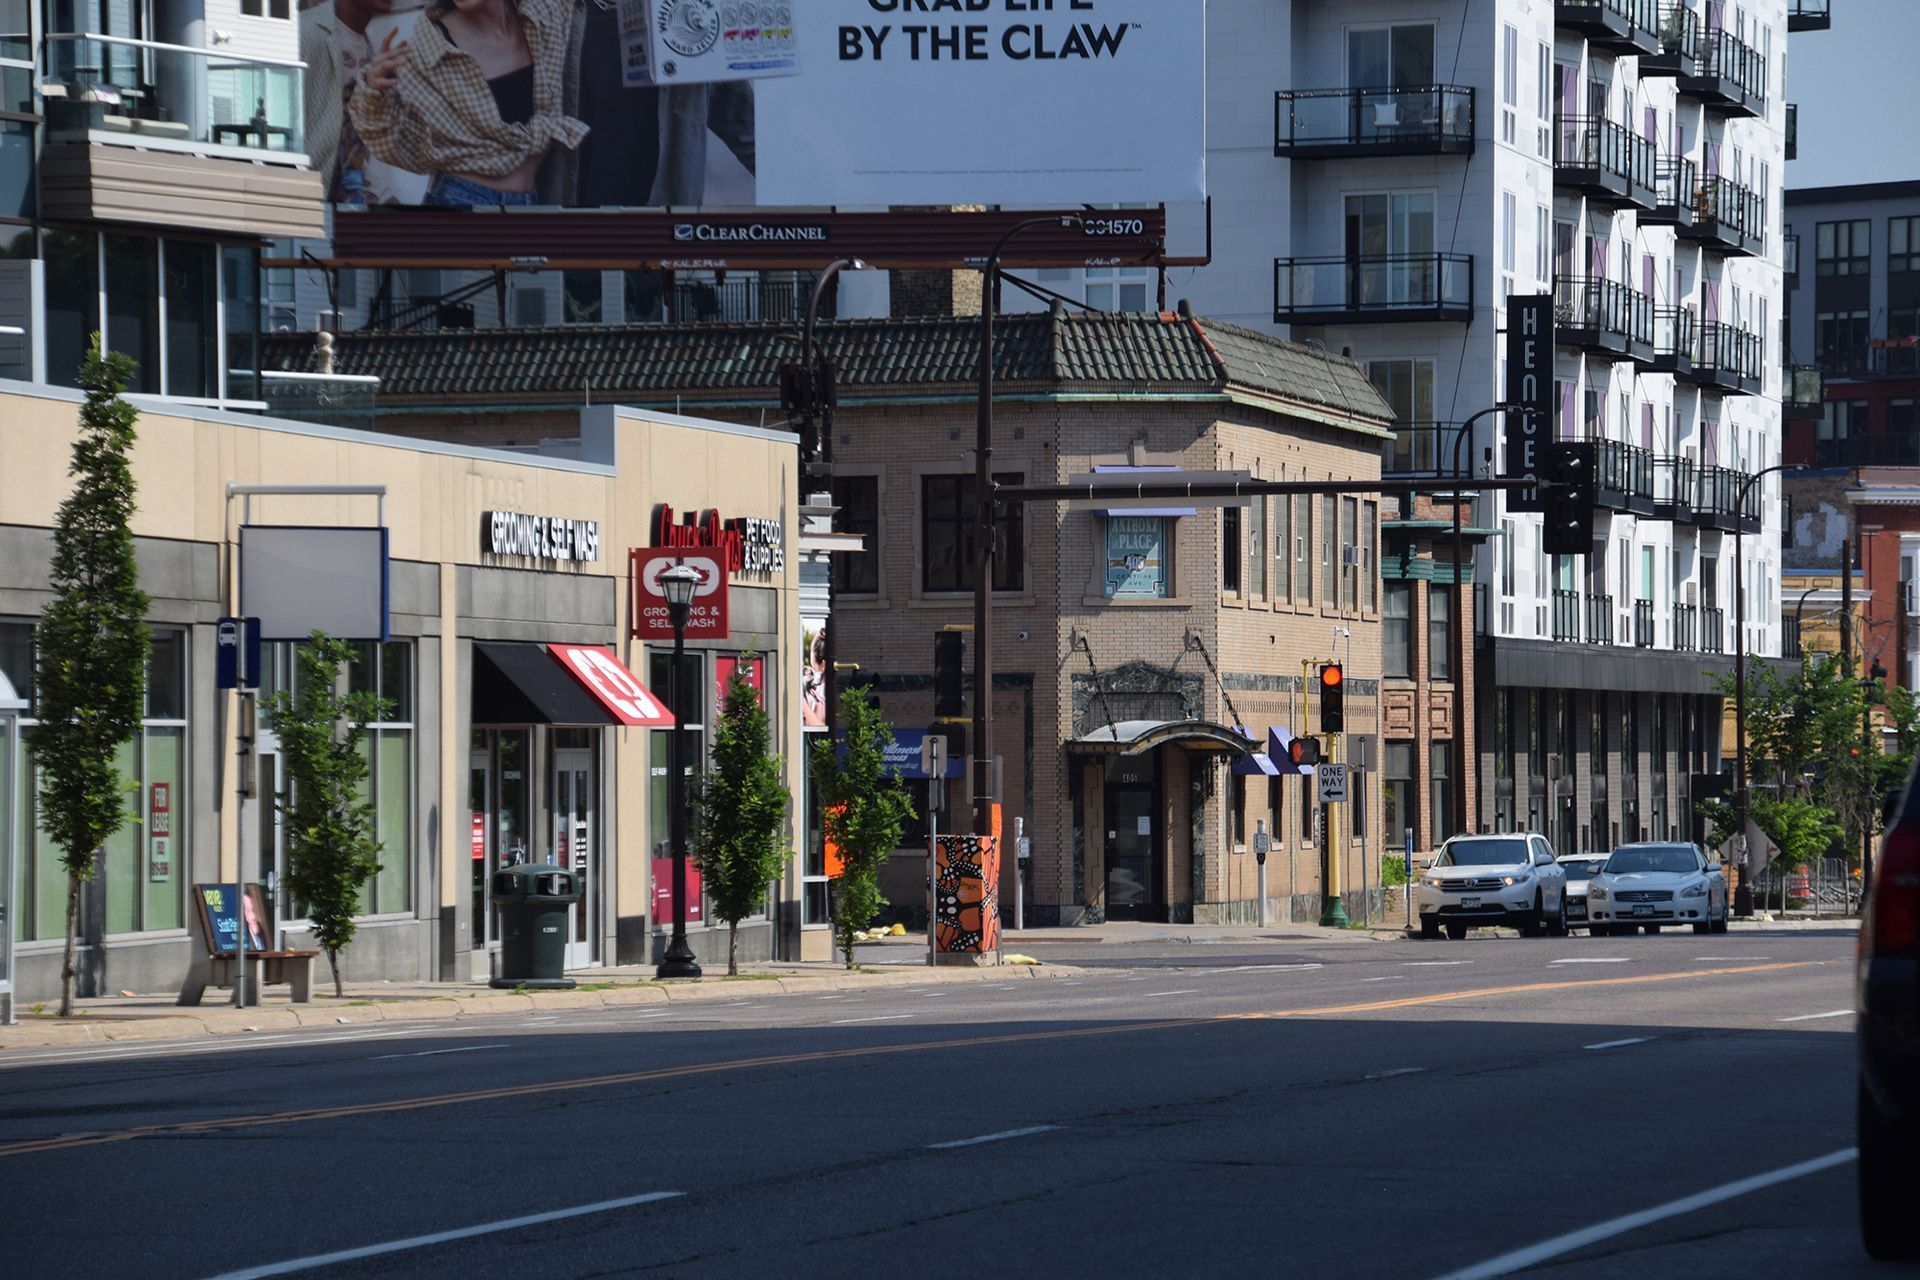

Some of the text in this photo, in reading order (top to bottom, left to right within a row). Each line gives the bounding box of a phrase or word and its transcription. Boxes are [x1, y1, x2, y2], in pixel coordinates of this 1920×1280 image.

[838, 25, 891, 60] BY
[901, 25, 988, 60] THE
[746, 517, 780, 545] PET FOOD
[1111, 517, 1158, 532] ANTHONY
[491, 511, 599, 561] GROOMING & SELF WASH
[1119, 534, 1153, 549] PLACE
[744, 545, 784, 572] & SUPPLIES
[643, 606, 720, 617] GRONG &
[649, 619, 675, 628] SEL
[1321, 767, 1343, 776] ONE
[1321, 777, 1344, 787] WAY
[152, 812, 169, 832] LEASE
